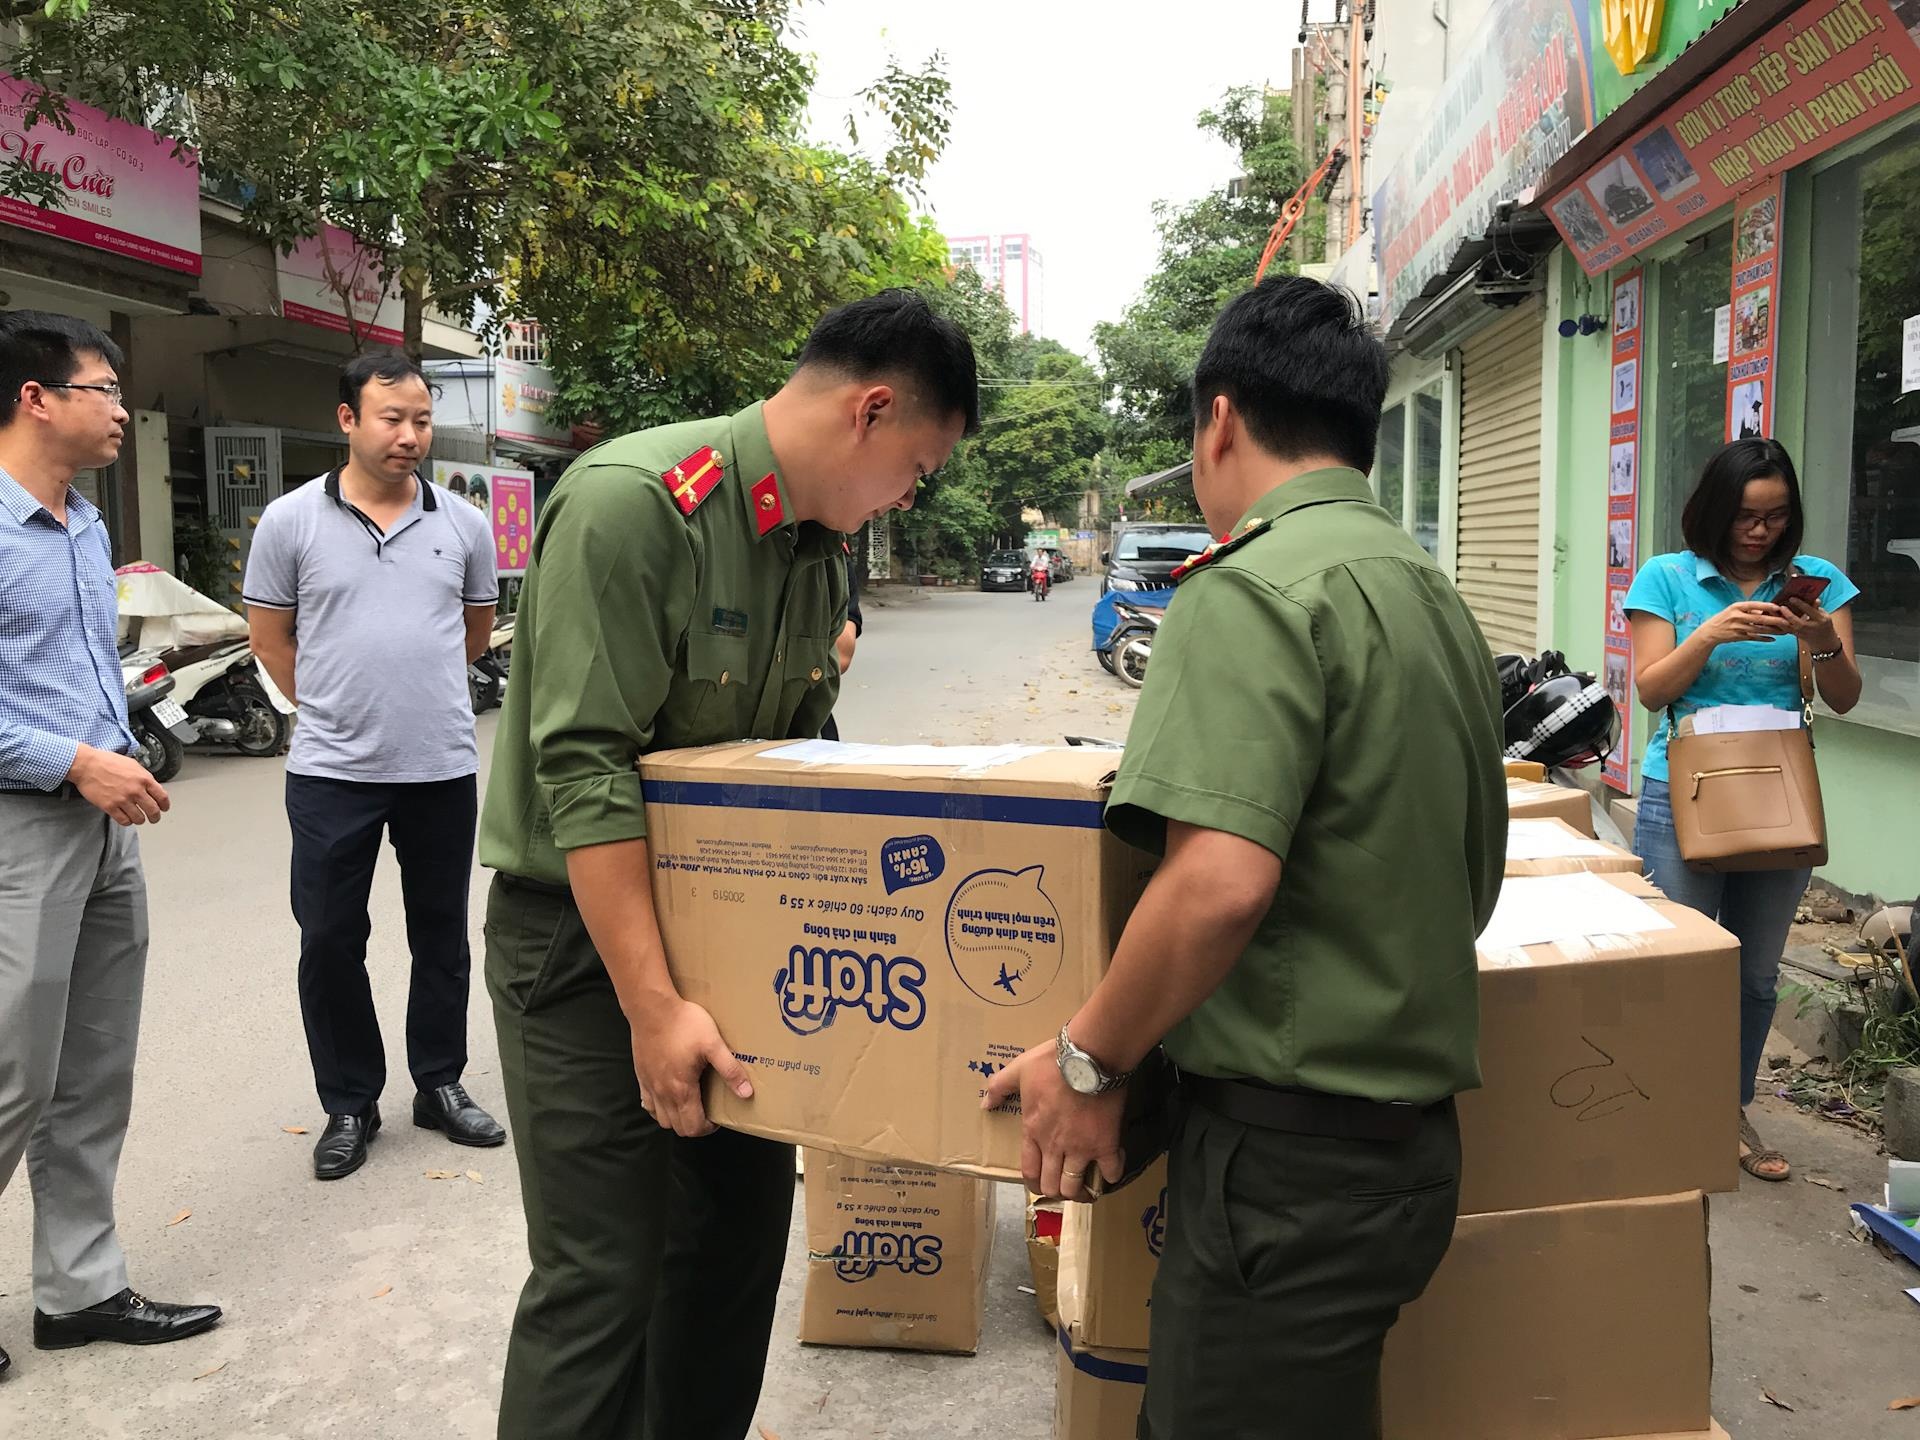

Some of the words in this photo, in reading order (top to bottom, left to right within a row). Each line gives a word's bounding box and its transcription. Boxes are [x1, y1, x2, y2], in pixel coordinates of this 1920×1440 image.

[1817, 0, 1885, 54] XUẤT,
[1785, 22, 1831, 74] SẢN
[1540, 32, 1568, 112] LOẠI
[1750, 45, 1791, 97] TIẾP
[1714, 75, 1760, 120] TRỰC
[1700, 99, 1730, 132] VỊ
[1709, 145, 1753, 187] NHẬP
[1745, 114, 1795, 166] KHẨU
[1784, 103, 1820, 144] VÀ
[1806, 82, 1868, 132] PHÂN
[1853, 44, 1911, 107] PHỐI
[1675, 109, 1713, 149] ĐƠN
[62, 154, 114, 198] Cười
[82, 200, 112, 218] SMILES
[888, 845, 927, 864] CANXI
[657, 860, 679, 871] Nghị
[703, 865, 722, 875] PHẨM
[723, 866, 741, 875] THỰC
[893, 857, 929, 878] 16%
[743, 867, 764, 877] PHẦN
[766, 870, 776, 880] CỔ
[788, 871, 810, 881] CÔNG
[830, 874, 849, 884] XUẤT
[851, 876, 868, 885] SẢN
[691, 887, 697, 897] 3
[712, 889, 745, 904] 200519
[779, 894, 787, 906] g
[790, 898, 805, 909] 55
[809, 899, 815, 908] x
[817, 900, 847, 914] chiếc
[850, 903, 864, 915] 60
[867, 904, 898, 918] cách:
[900, 906, 924, 921] Quy
[957, 909, 982, 920] trình
[985, 912, 1010, 924] hành
[1012, 912, 1031, 925] mọi
[1033, 916, 1056, 928] trên
[803, 923, 830, 938] bông
[832, 927, 851, 940] chà
[853, 930, 867, 942] mì
[961, 923, 994, 937] dưỡng
[996, 928, 1019, 940] dinh
[869, 931, 896, 945] Bánh
[1021, 931, 1033, 943] ăn
[1035, 932, 1056, 944] Bữa
[783, 945, 927, 1031] Staff
[760, 1056, 775, 1068] của
[777, 1060, 802, 1072] phẩm
[803, 1063, 821, 1076] Sản
[844, 1203, 855, 1211] 55
[864, 1204, 886, 1213] chiếc
[900, 1207, 922, 1215] cách:
[923, 1207, 940, 1216] Quy
[855, 1217, 874, 1226] bông
[876, 1219, 889, 1228] chà
[891, 1220, 901, 1228] mì
[902, 1221, 922, 1229] Bánh
[837, 1231, 943, 1276] Staff
[894, 1312, 905, 1320] của
[907, 1312, 924, 1321] phẩm
[925, 1313, 938, 1322] Sản
